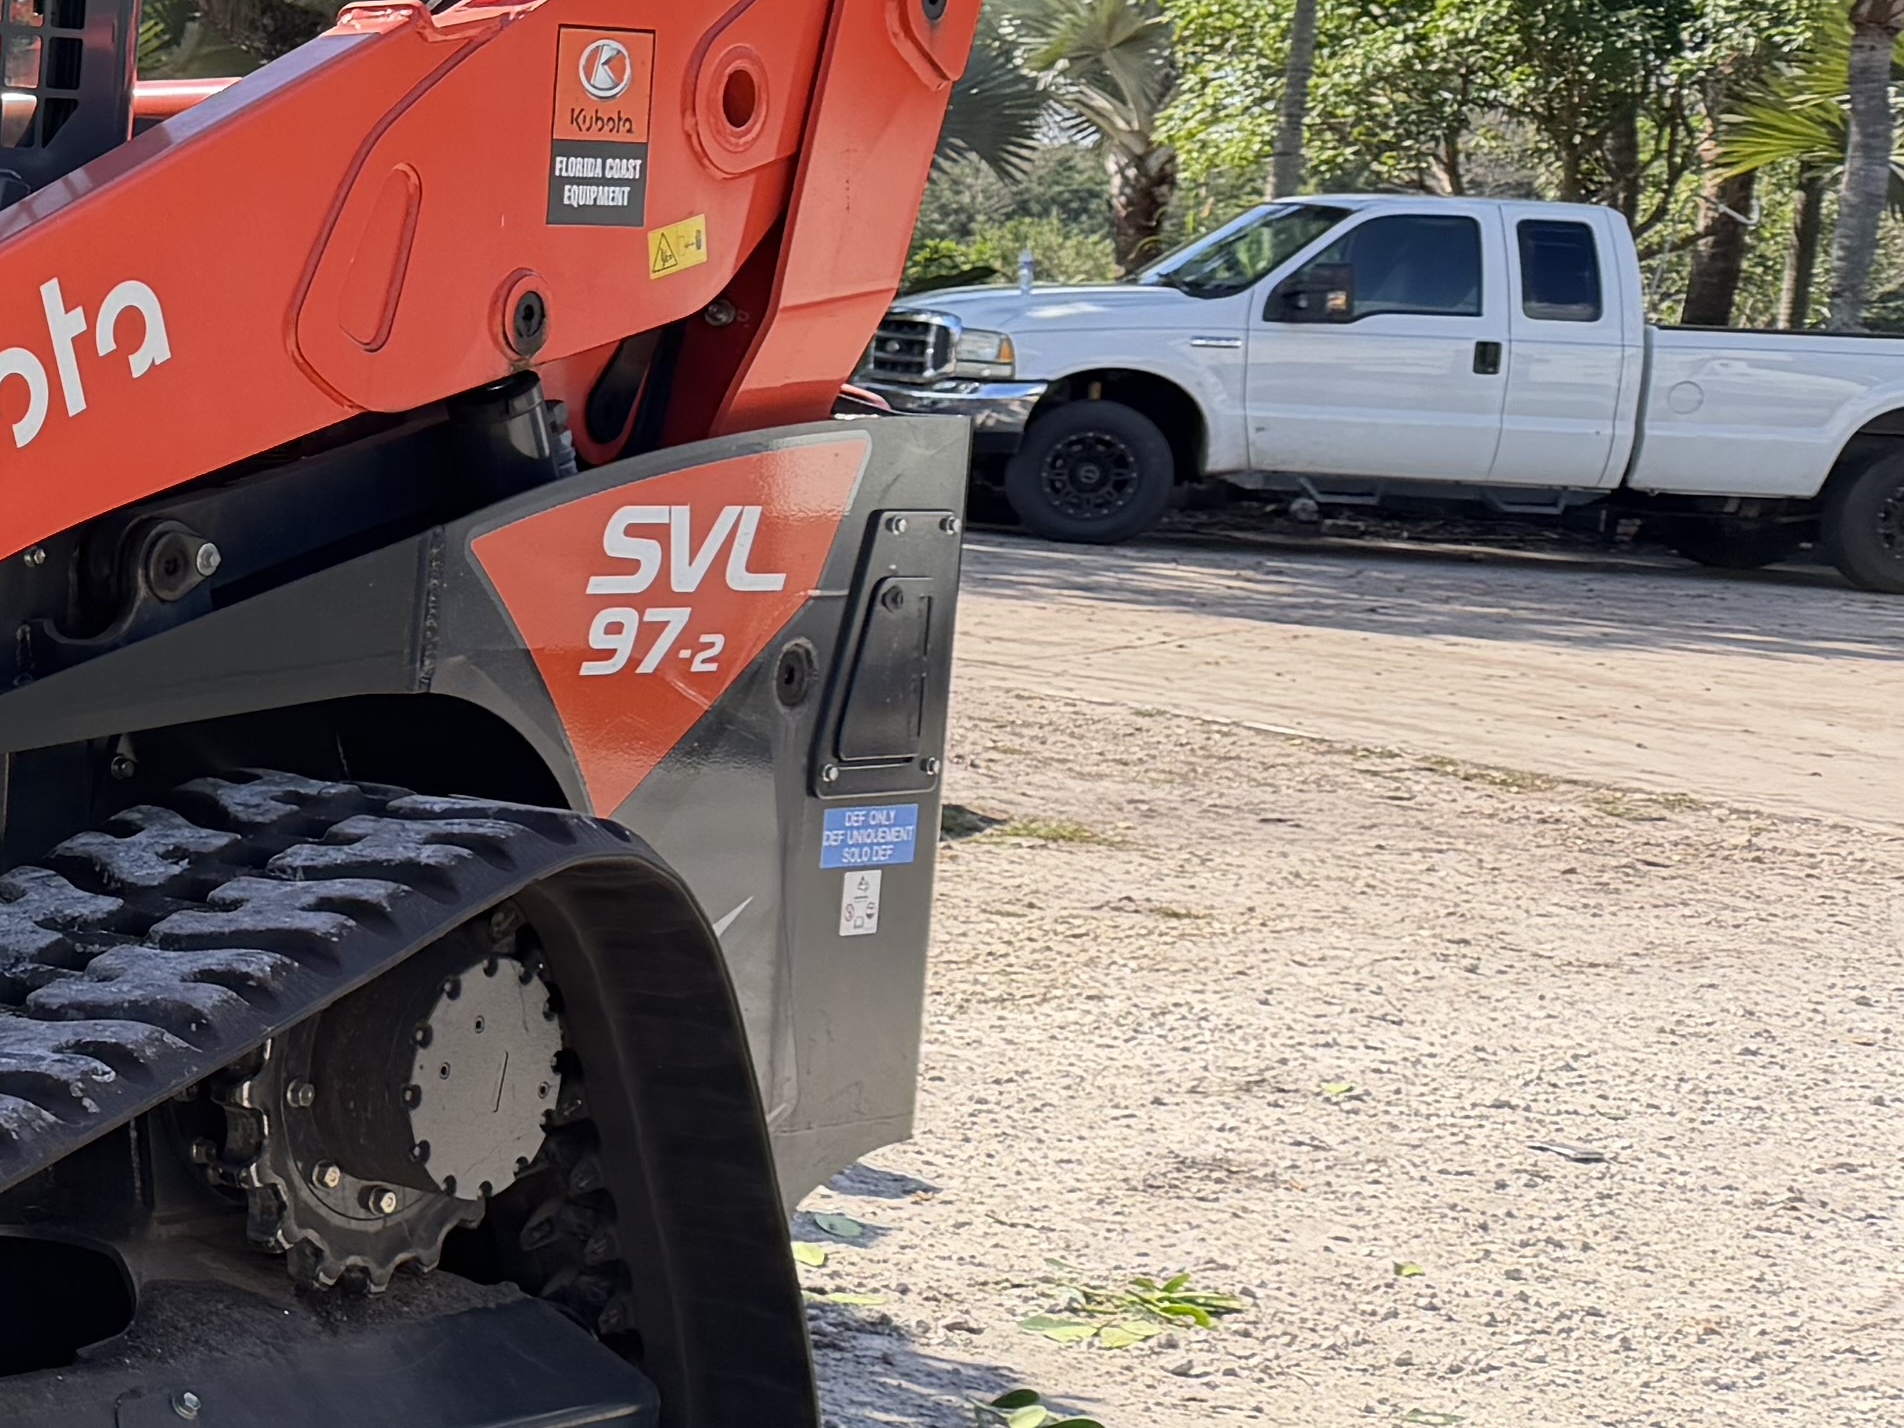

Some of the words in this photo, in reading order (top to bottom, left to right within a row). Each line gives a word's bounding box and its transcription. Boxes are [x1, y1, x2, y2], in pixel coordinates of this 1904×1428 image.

[571, 108, 634, 134] Kubota
[555, 156, 602, 178] FLORIDA
[605, 158, 642, 179] COAST
[563, 185, 630, 207] EQUIPMENT
[585, 504, 787, 595] SVL
[845, 811, 867, 826] DEF
[869, 810, 896, 825] ONLY
[823, 831, 845, 846] DEF
[848, 826, 914, 845] UNIQUEMENT
[842, 846, 871, 863] SOLO
[872, 845, 894, 861] DEF
